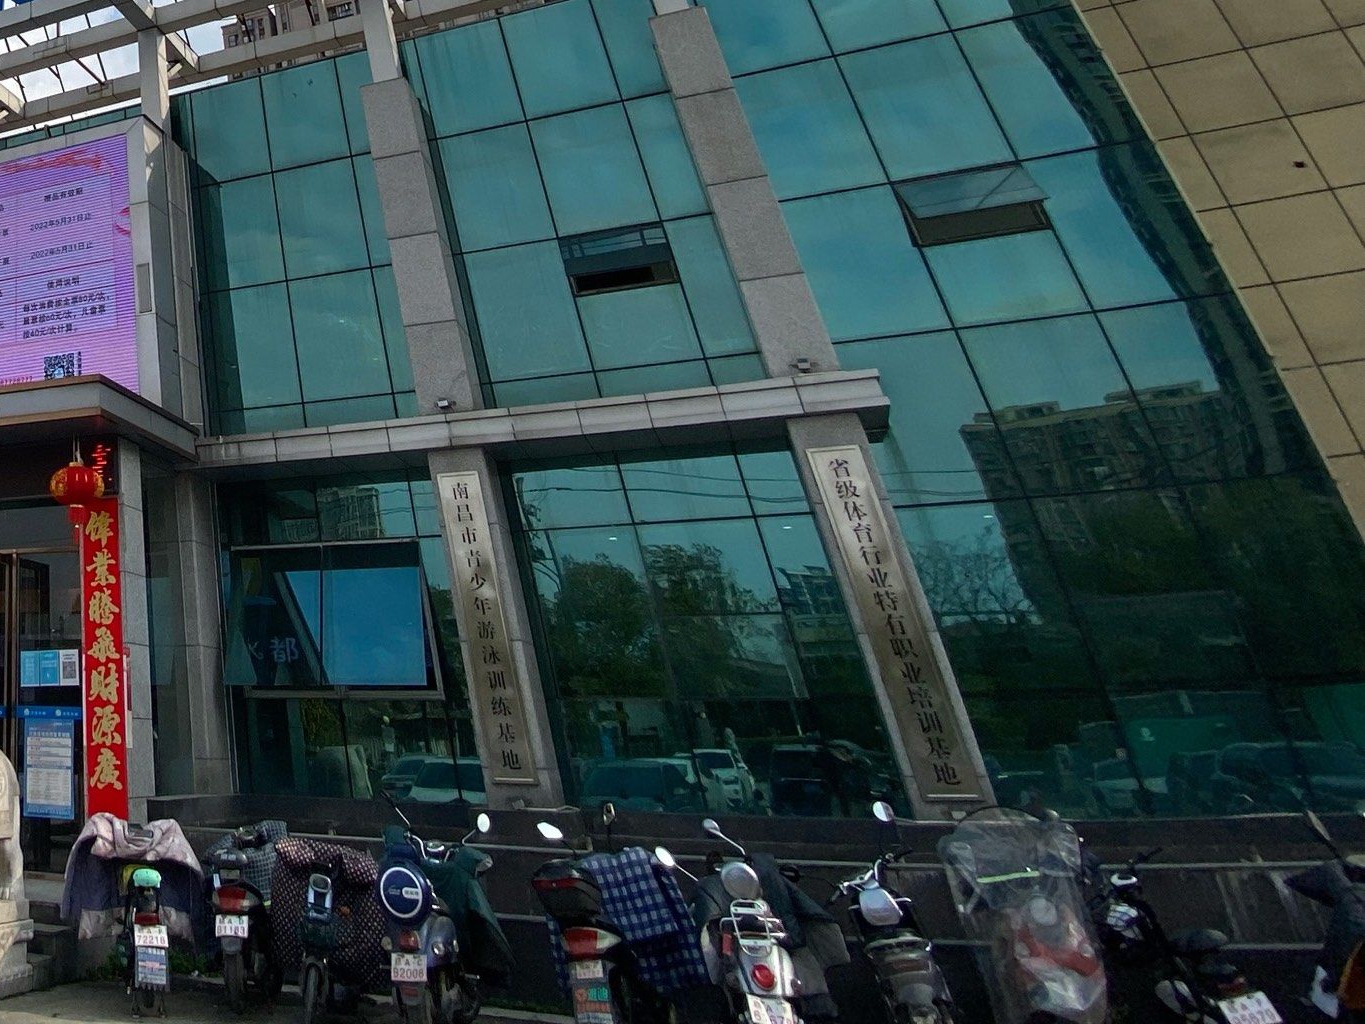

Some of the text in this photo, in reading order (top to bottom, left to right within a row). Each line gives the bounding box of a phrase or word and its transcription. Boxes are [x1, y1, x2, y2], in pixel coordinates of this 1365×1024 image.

[451, 481, 522, 771] 南昌市青少年游泳训练基地
[828, 457, 962, 787] 省级体育行业特有职业培训基地
